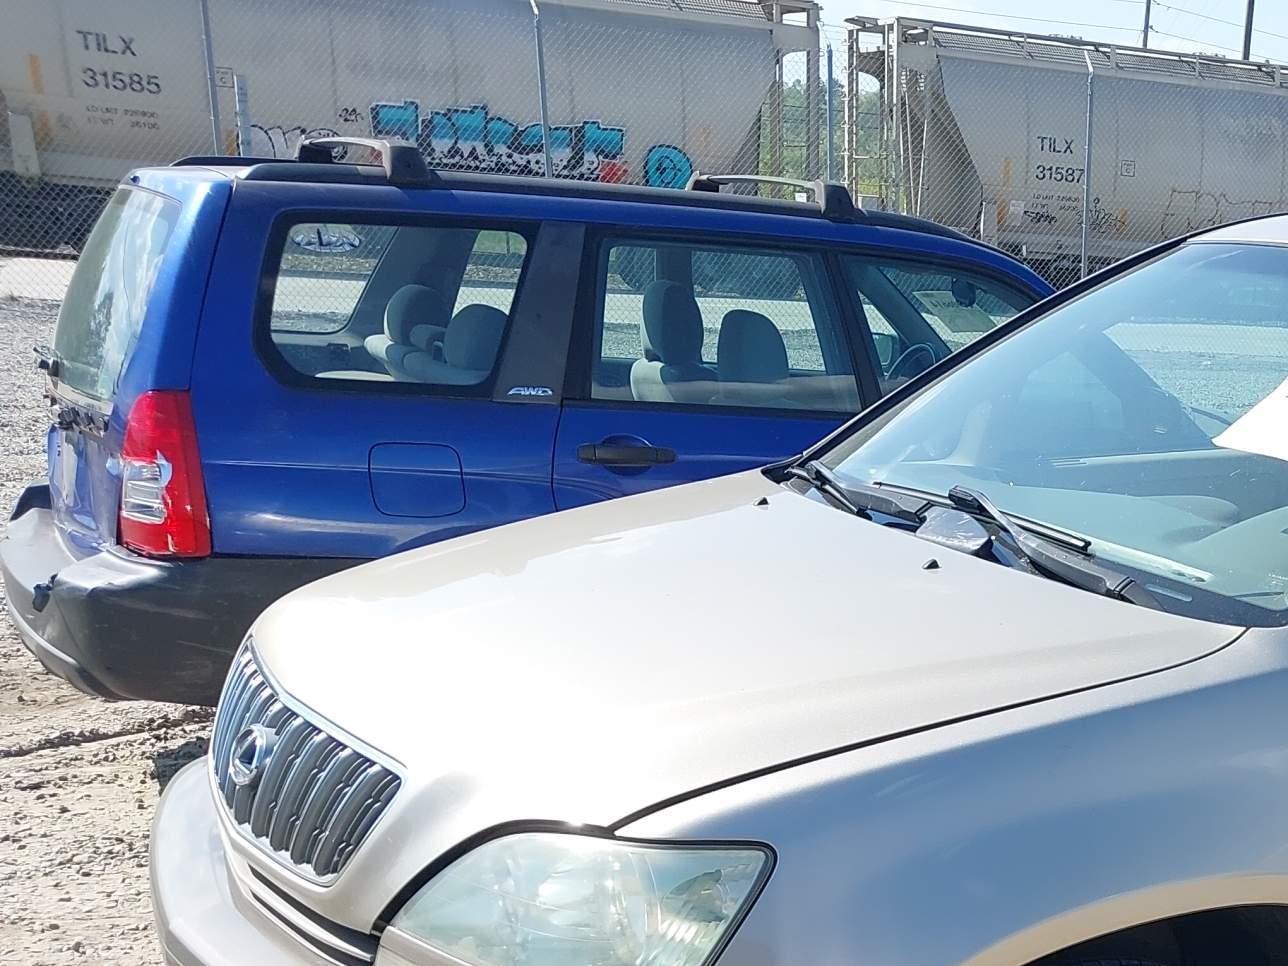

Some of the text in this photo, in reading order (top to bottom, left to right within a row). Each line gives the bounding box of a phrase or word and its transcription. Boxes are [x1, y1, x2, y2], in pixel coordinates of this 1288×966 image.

[75, 30, 137, 57] TILX
[82, 67, 162, 95] 31585
[1037, 136, 1074, 154] TILX
[1035, 164, 1085, 184] 31587
[507, 386, 553, 396] AWD
